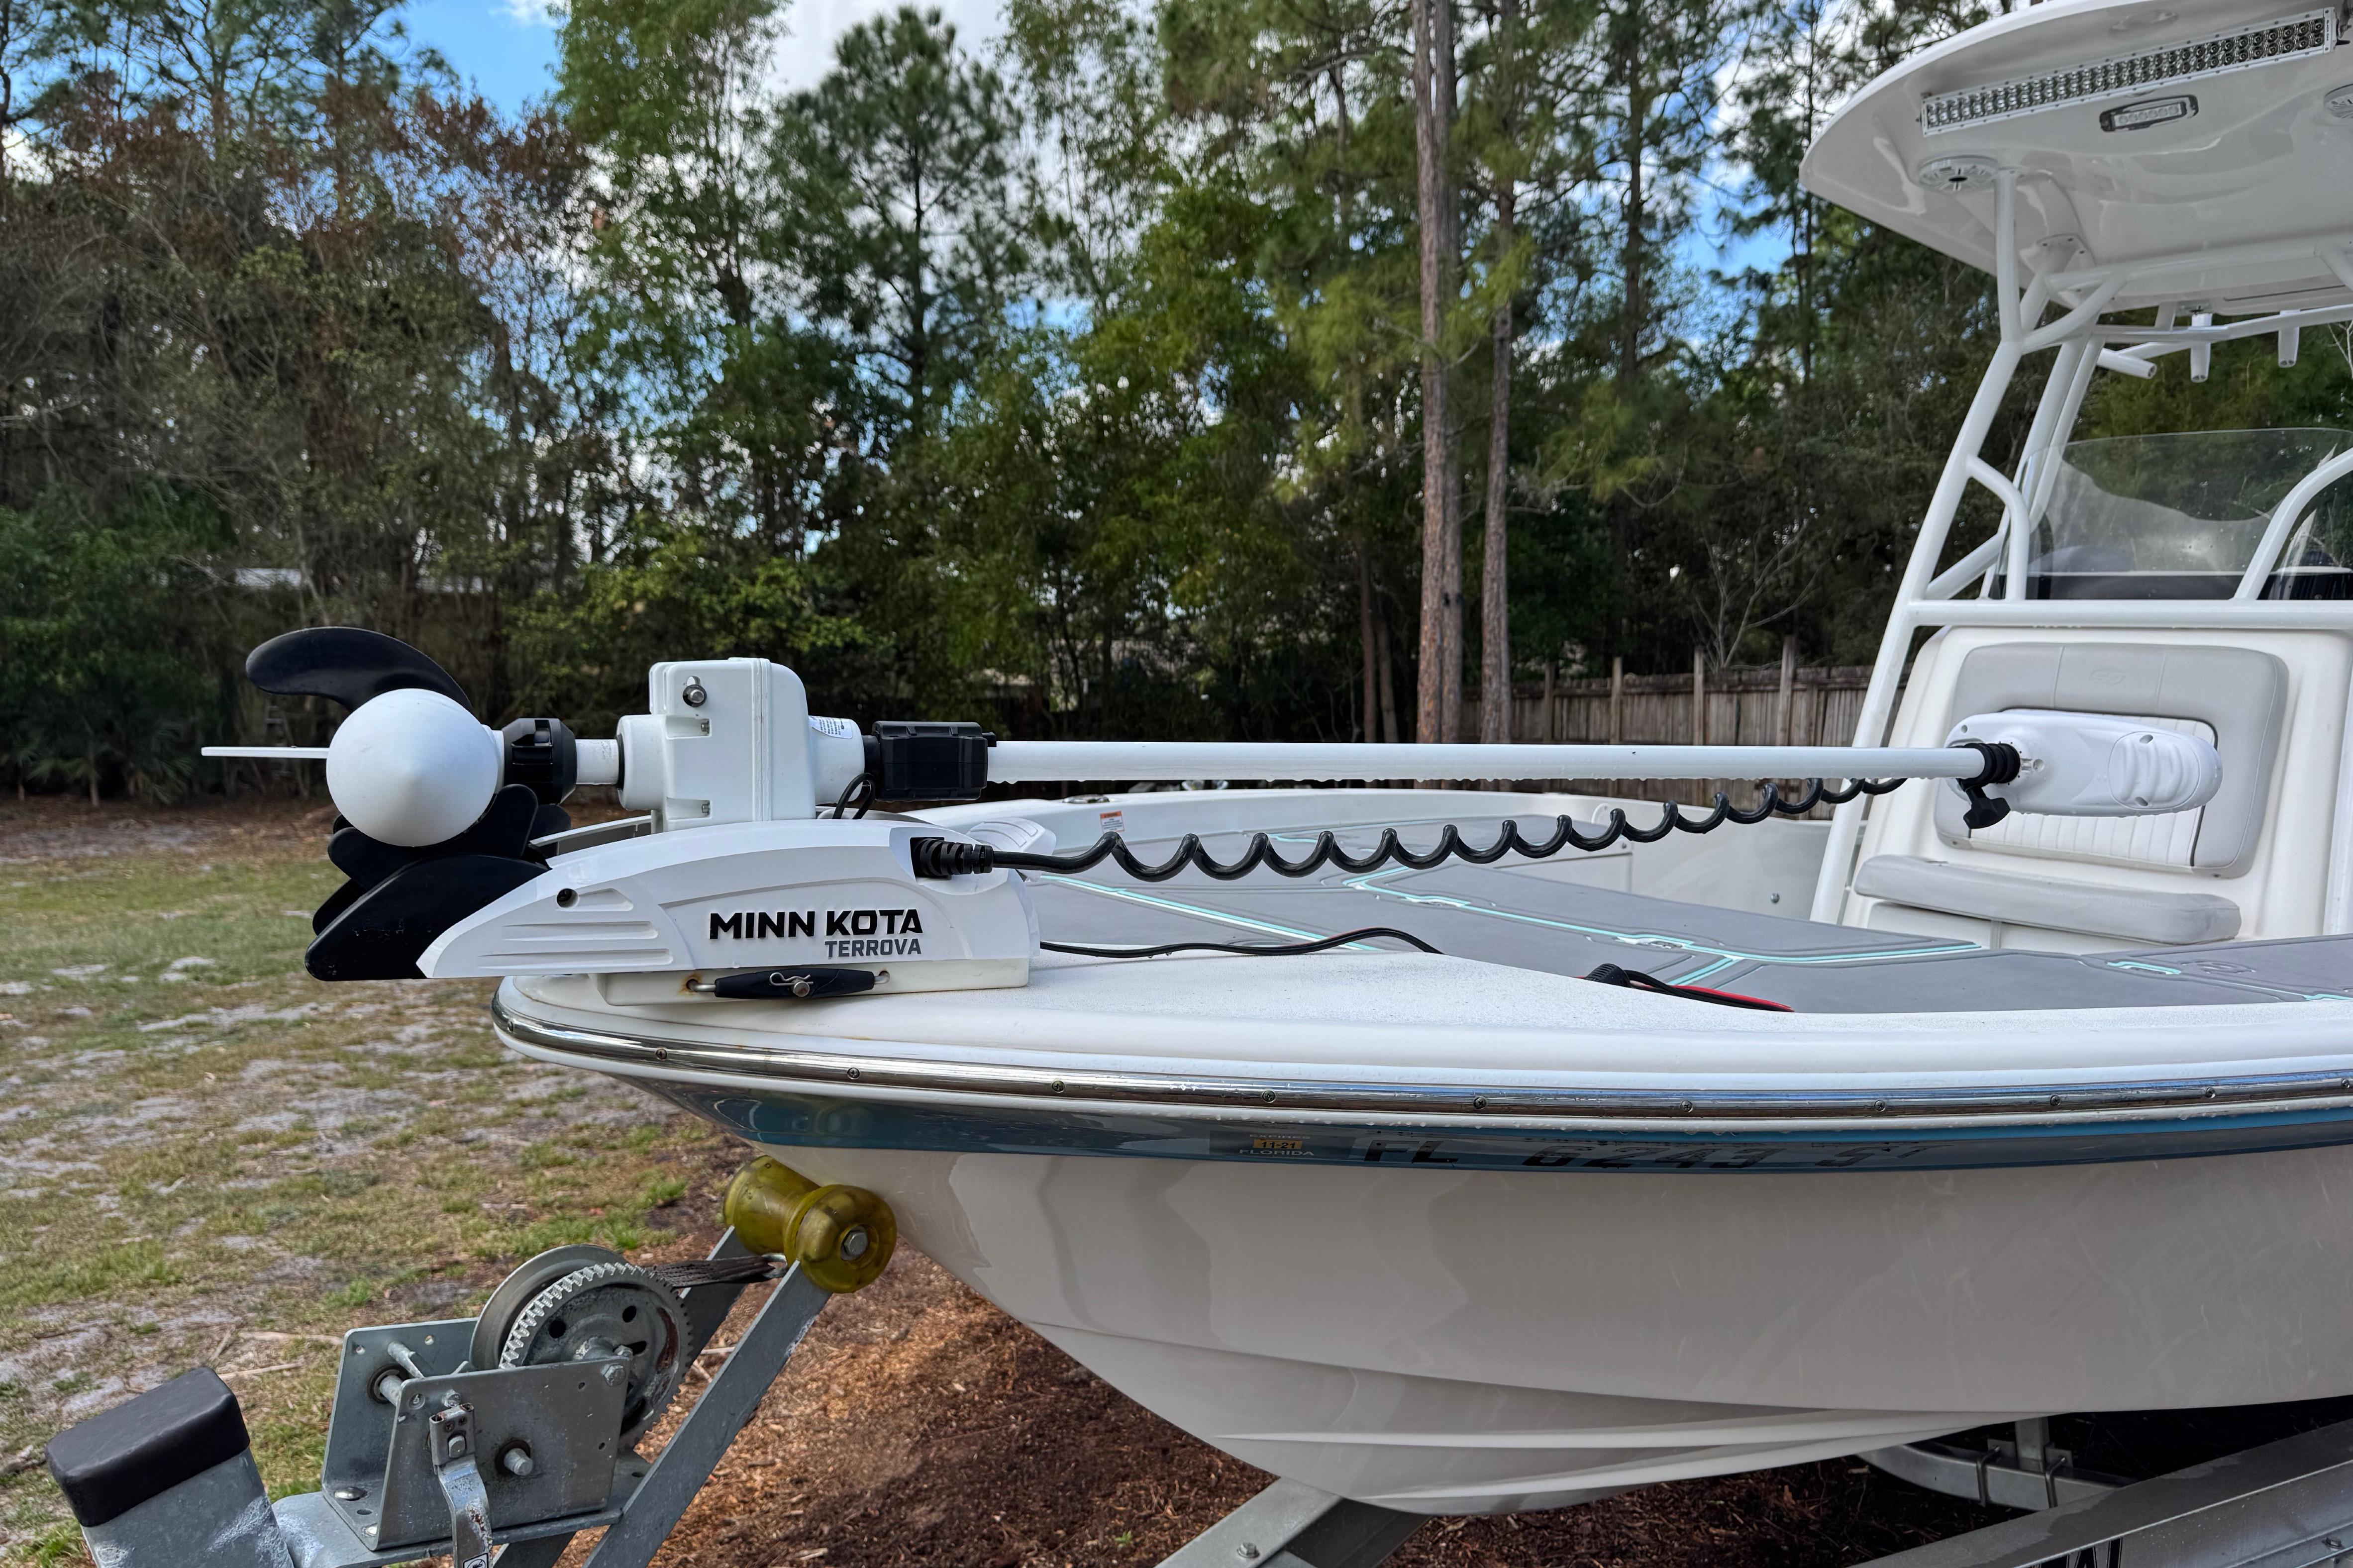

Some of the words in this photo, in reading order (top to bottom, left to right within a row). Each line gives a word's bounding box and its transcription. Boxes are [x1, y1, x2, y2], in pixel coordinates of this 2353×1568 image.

[710, 911, 816, 939] MINN
[826, 909, 923, 936] KOTA
[824, 938, 921, 958] TERROVA
[1364, 1140, 1459, 1163] FL
[1522, 1146, 1787, 1169] 6243
